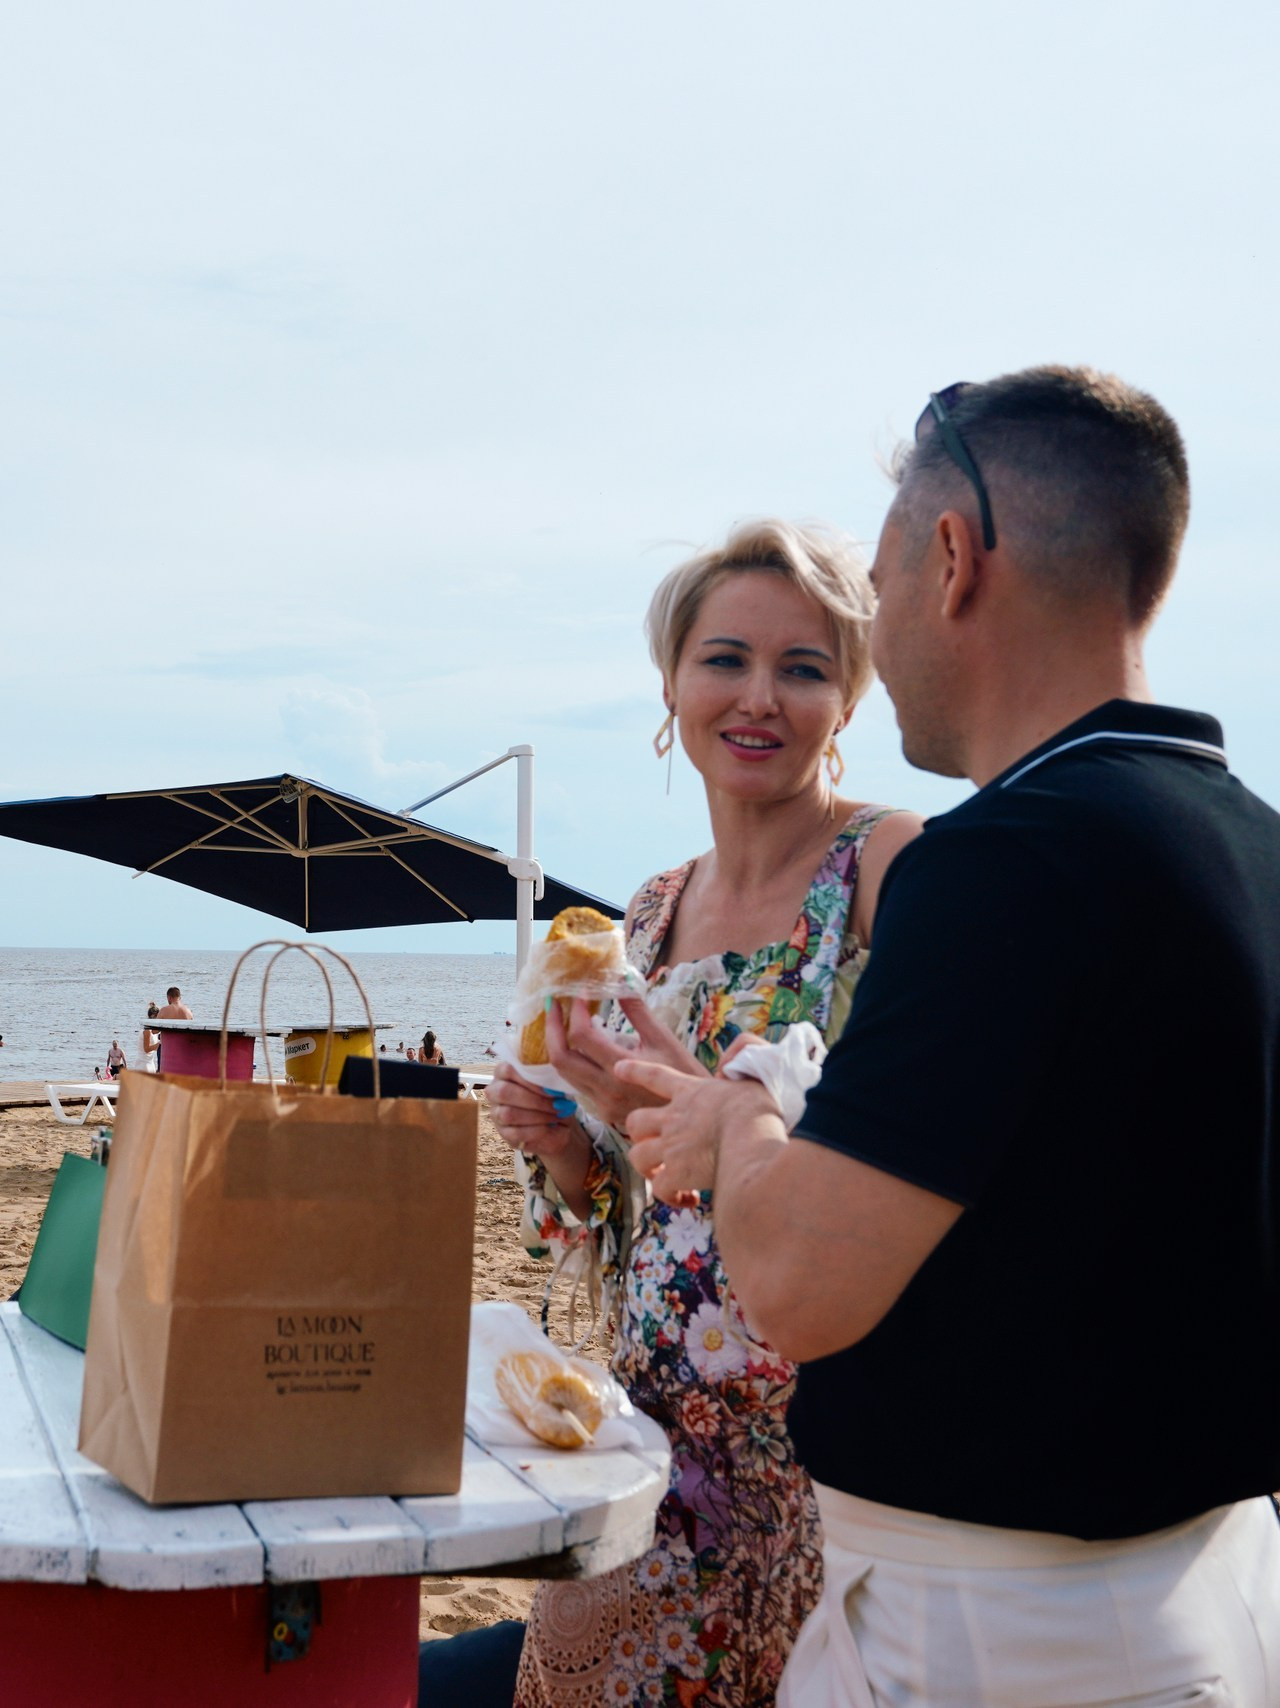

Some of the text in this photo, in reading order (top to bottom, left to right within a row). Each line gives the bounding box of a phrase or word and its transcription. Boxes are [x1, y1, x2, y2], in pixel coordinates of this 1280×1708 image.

[287, 1042, 310, 1056] Маркет
[277, 1315, 363, 1337] LA MOON
[265, 1341, 375, 1364] BOUTIQUE
